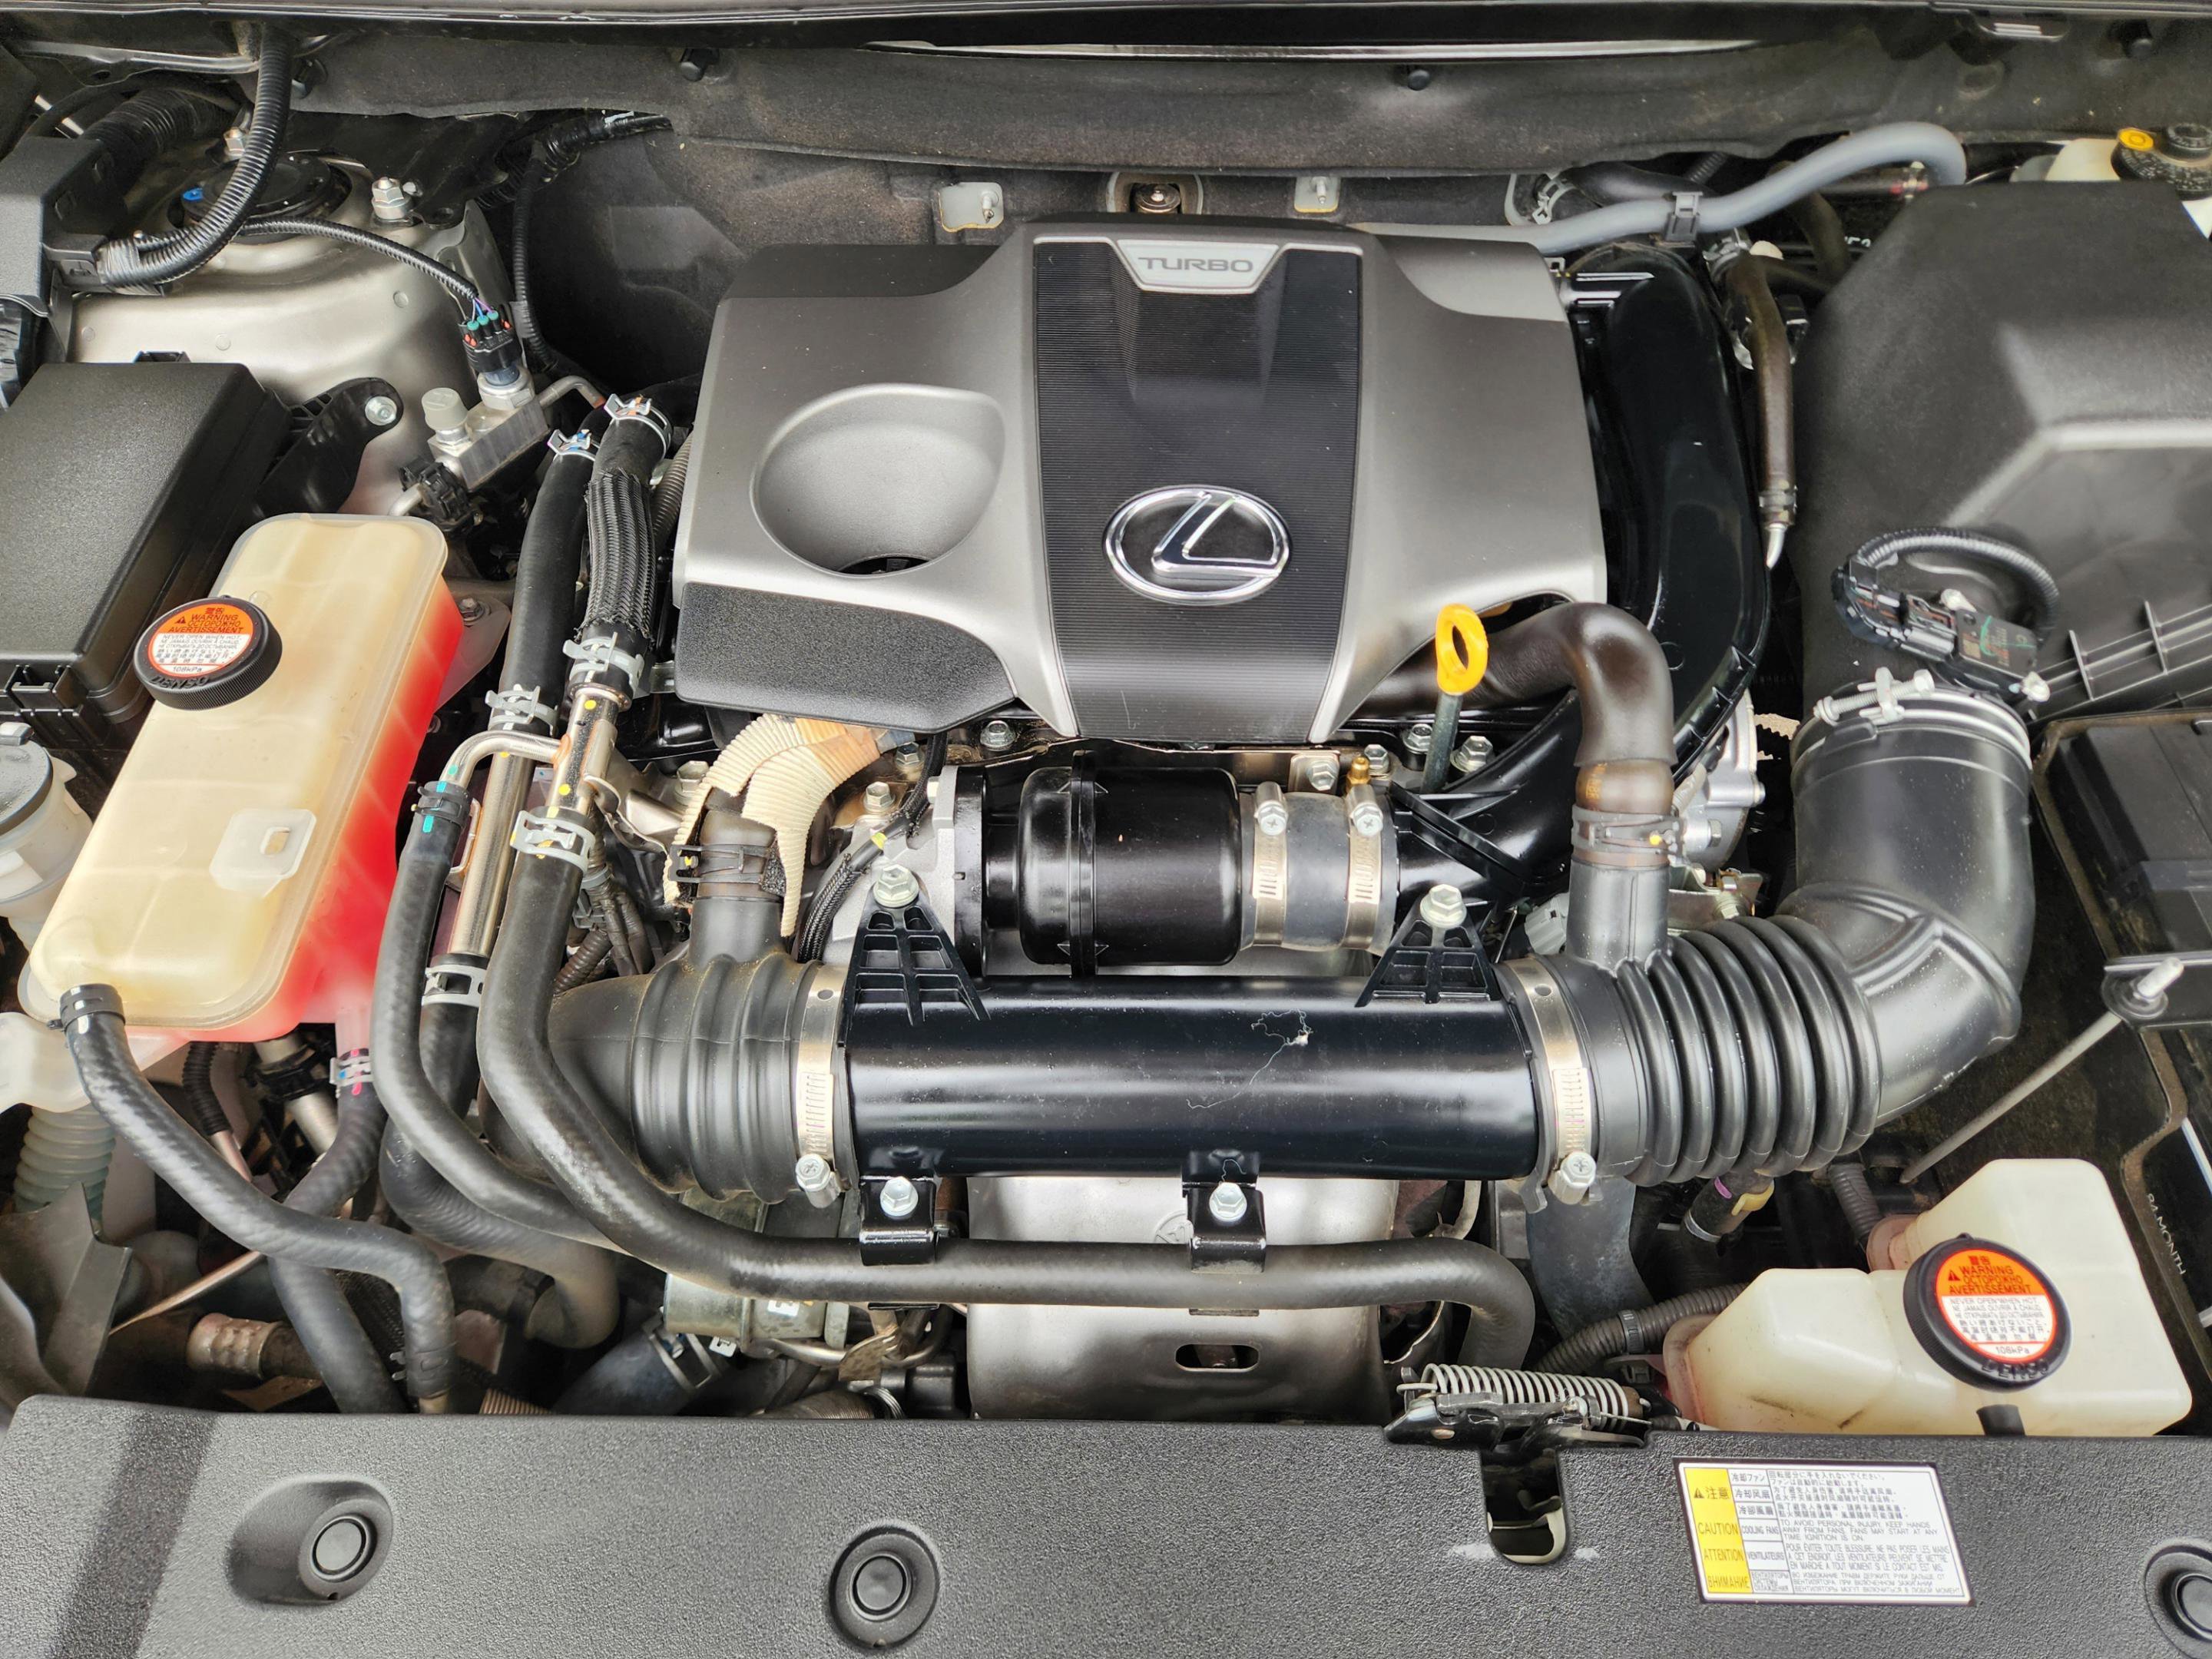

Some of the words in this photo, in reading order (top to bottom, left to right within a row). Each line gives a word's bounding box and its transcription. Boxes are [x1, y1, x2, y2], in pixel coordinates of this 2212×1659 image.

[1137, 257, 1253, 273] TURBO
[1959, 1266, 2014, 1275] WARNING
[1949, 1285, 2032, 1293] AVERTISSEMENT
[1982, 1359, 2049, 1379] DENSO
[1731, 1472, 1765, 1482] 冷却ファン
[1704, 1486, 1730, 1499] 注意
[1697, 1522, 1738, 1535] CAUTION
[1740, 1525, 1763, 1534] COOLING
[1765, 1525, 1779, 1534] FANS
[1920, 1545, 1930, 1553] LES
[1702, 1548, 1743, 1561] ATTENTION
[1747, 1551, 1784, 1560] VENTILATEURS
[1790, 1561, 1798, 1569] EN
[1848, 1561, 1873, 1570] MOMENT
[1891, 1562, 1917, 1571] CONTACT
[1707, 1575, 1750, 1588] ВНИМАНИЕ
